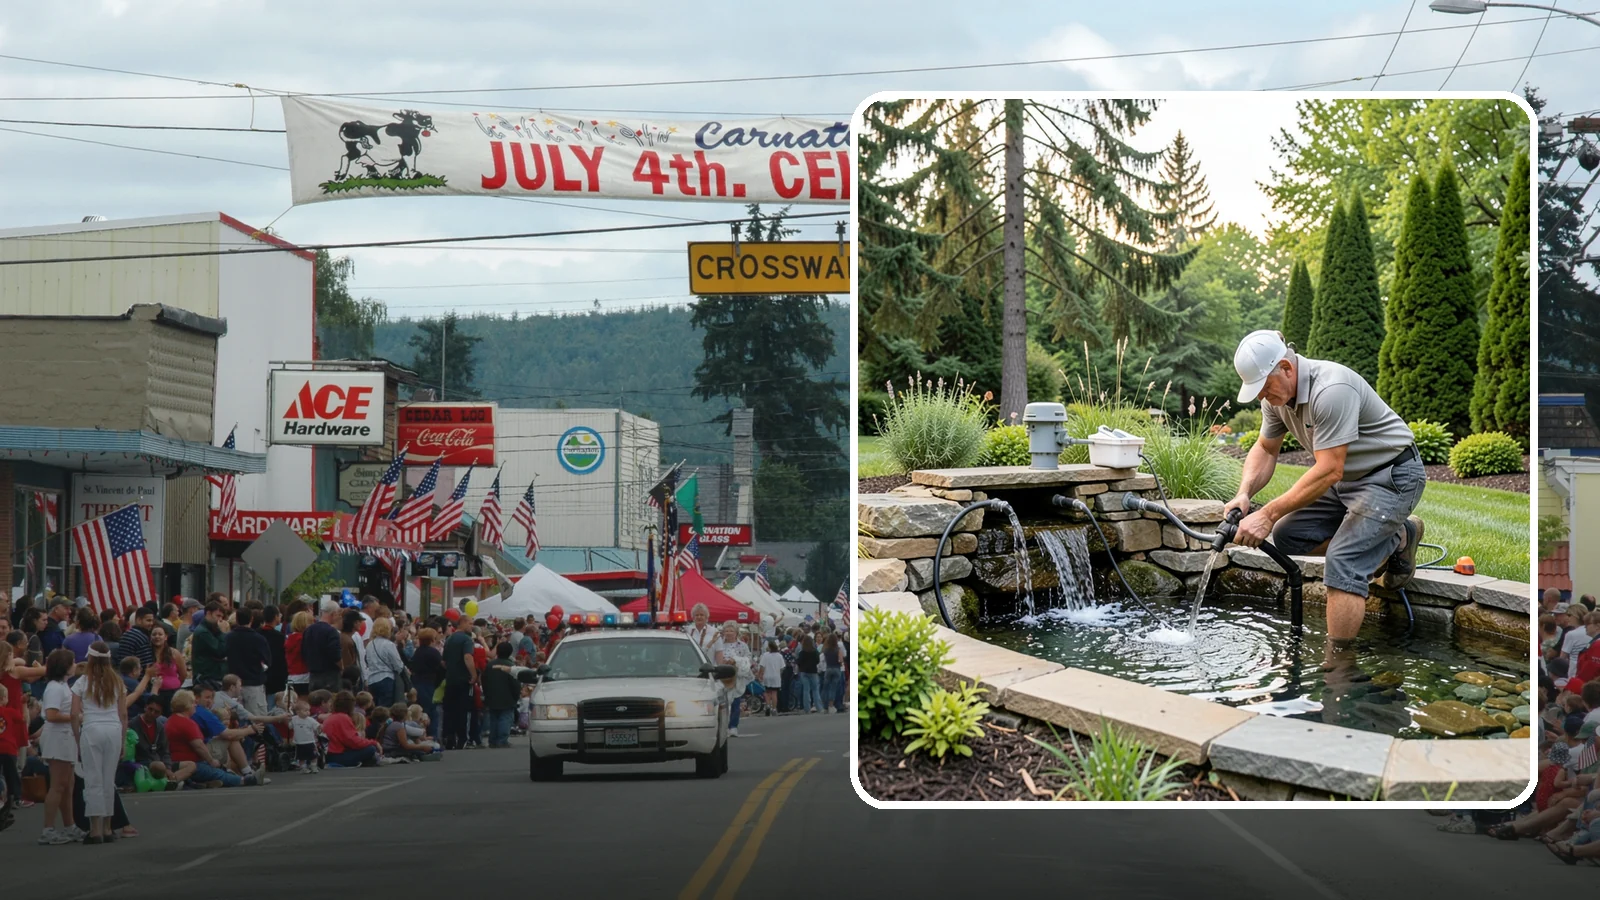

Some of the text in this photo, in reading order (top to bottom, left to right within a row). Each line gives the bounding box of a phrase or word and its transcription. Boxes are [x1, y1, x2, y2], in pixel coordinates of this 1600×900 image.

[481, 141, 605, 193] JULY
[632, 150, 747, 198] 4th.
[696, 254, 850, 280] CROSSWA
[282, 380, 374, 420] ACE
[405, 409, 453, 422] CEDAR
[283, 421, 371, 437] Hardware
[416, 428, 477, 447] Coca-Cola
[353, 466, 386, 481] Simpl
[83, 485, 155, 495] St. Vincent de Paul
[213, 516, 331, 536] HARDARE
[688, 526, 742, 535] CRNATION
[699, 535, 730, 543] GLASS
